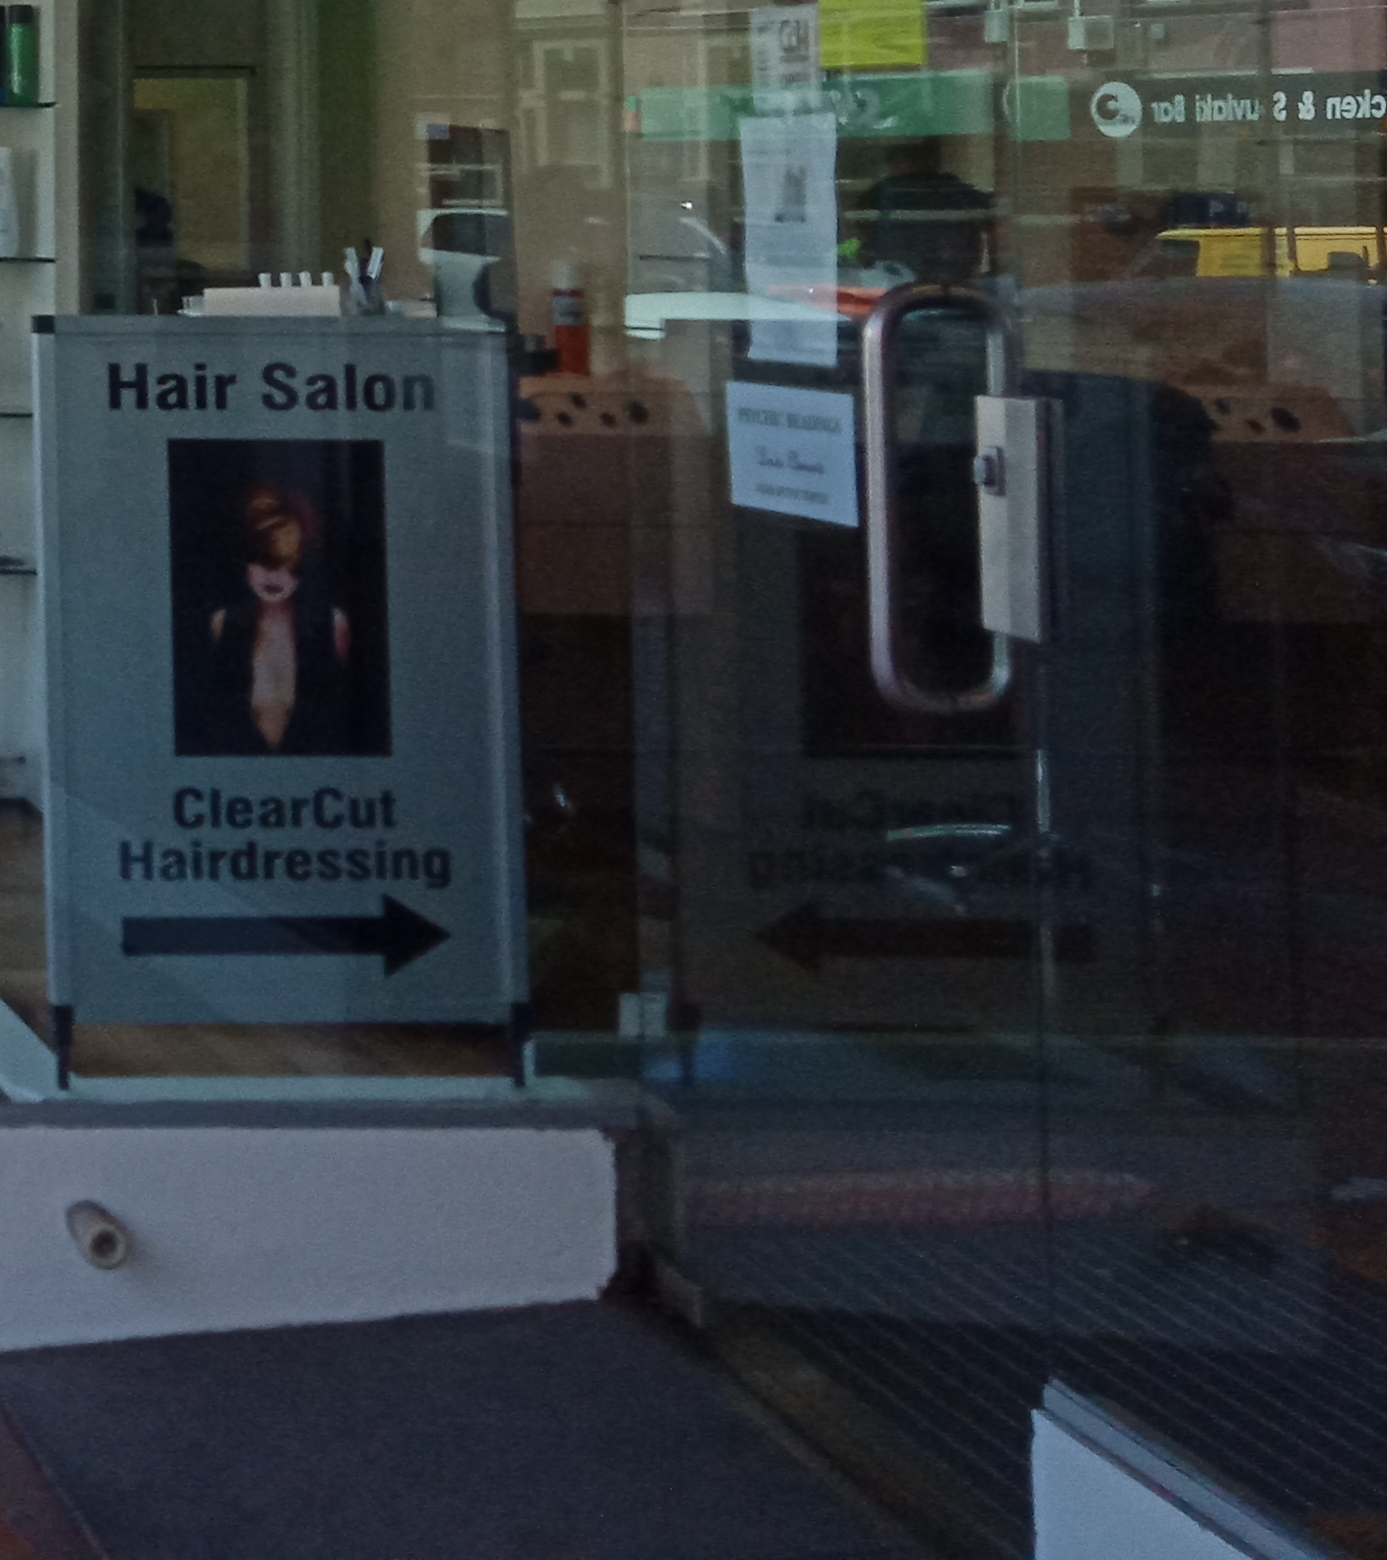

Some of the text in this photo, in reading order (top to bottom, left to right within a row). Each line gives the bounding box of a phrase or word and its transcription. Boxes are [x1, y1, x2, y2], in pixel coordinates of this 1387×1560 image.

[107, 362, 437, 413] Hair Salon
[171, 785, 397, 831] ClearCut
[118, 838, 453, 890] Hairdressing
